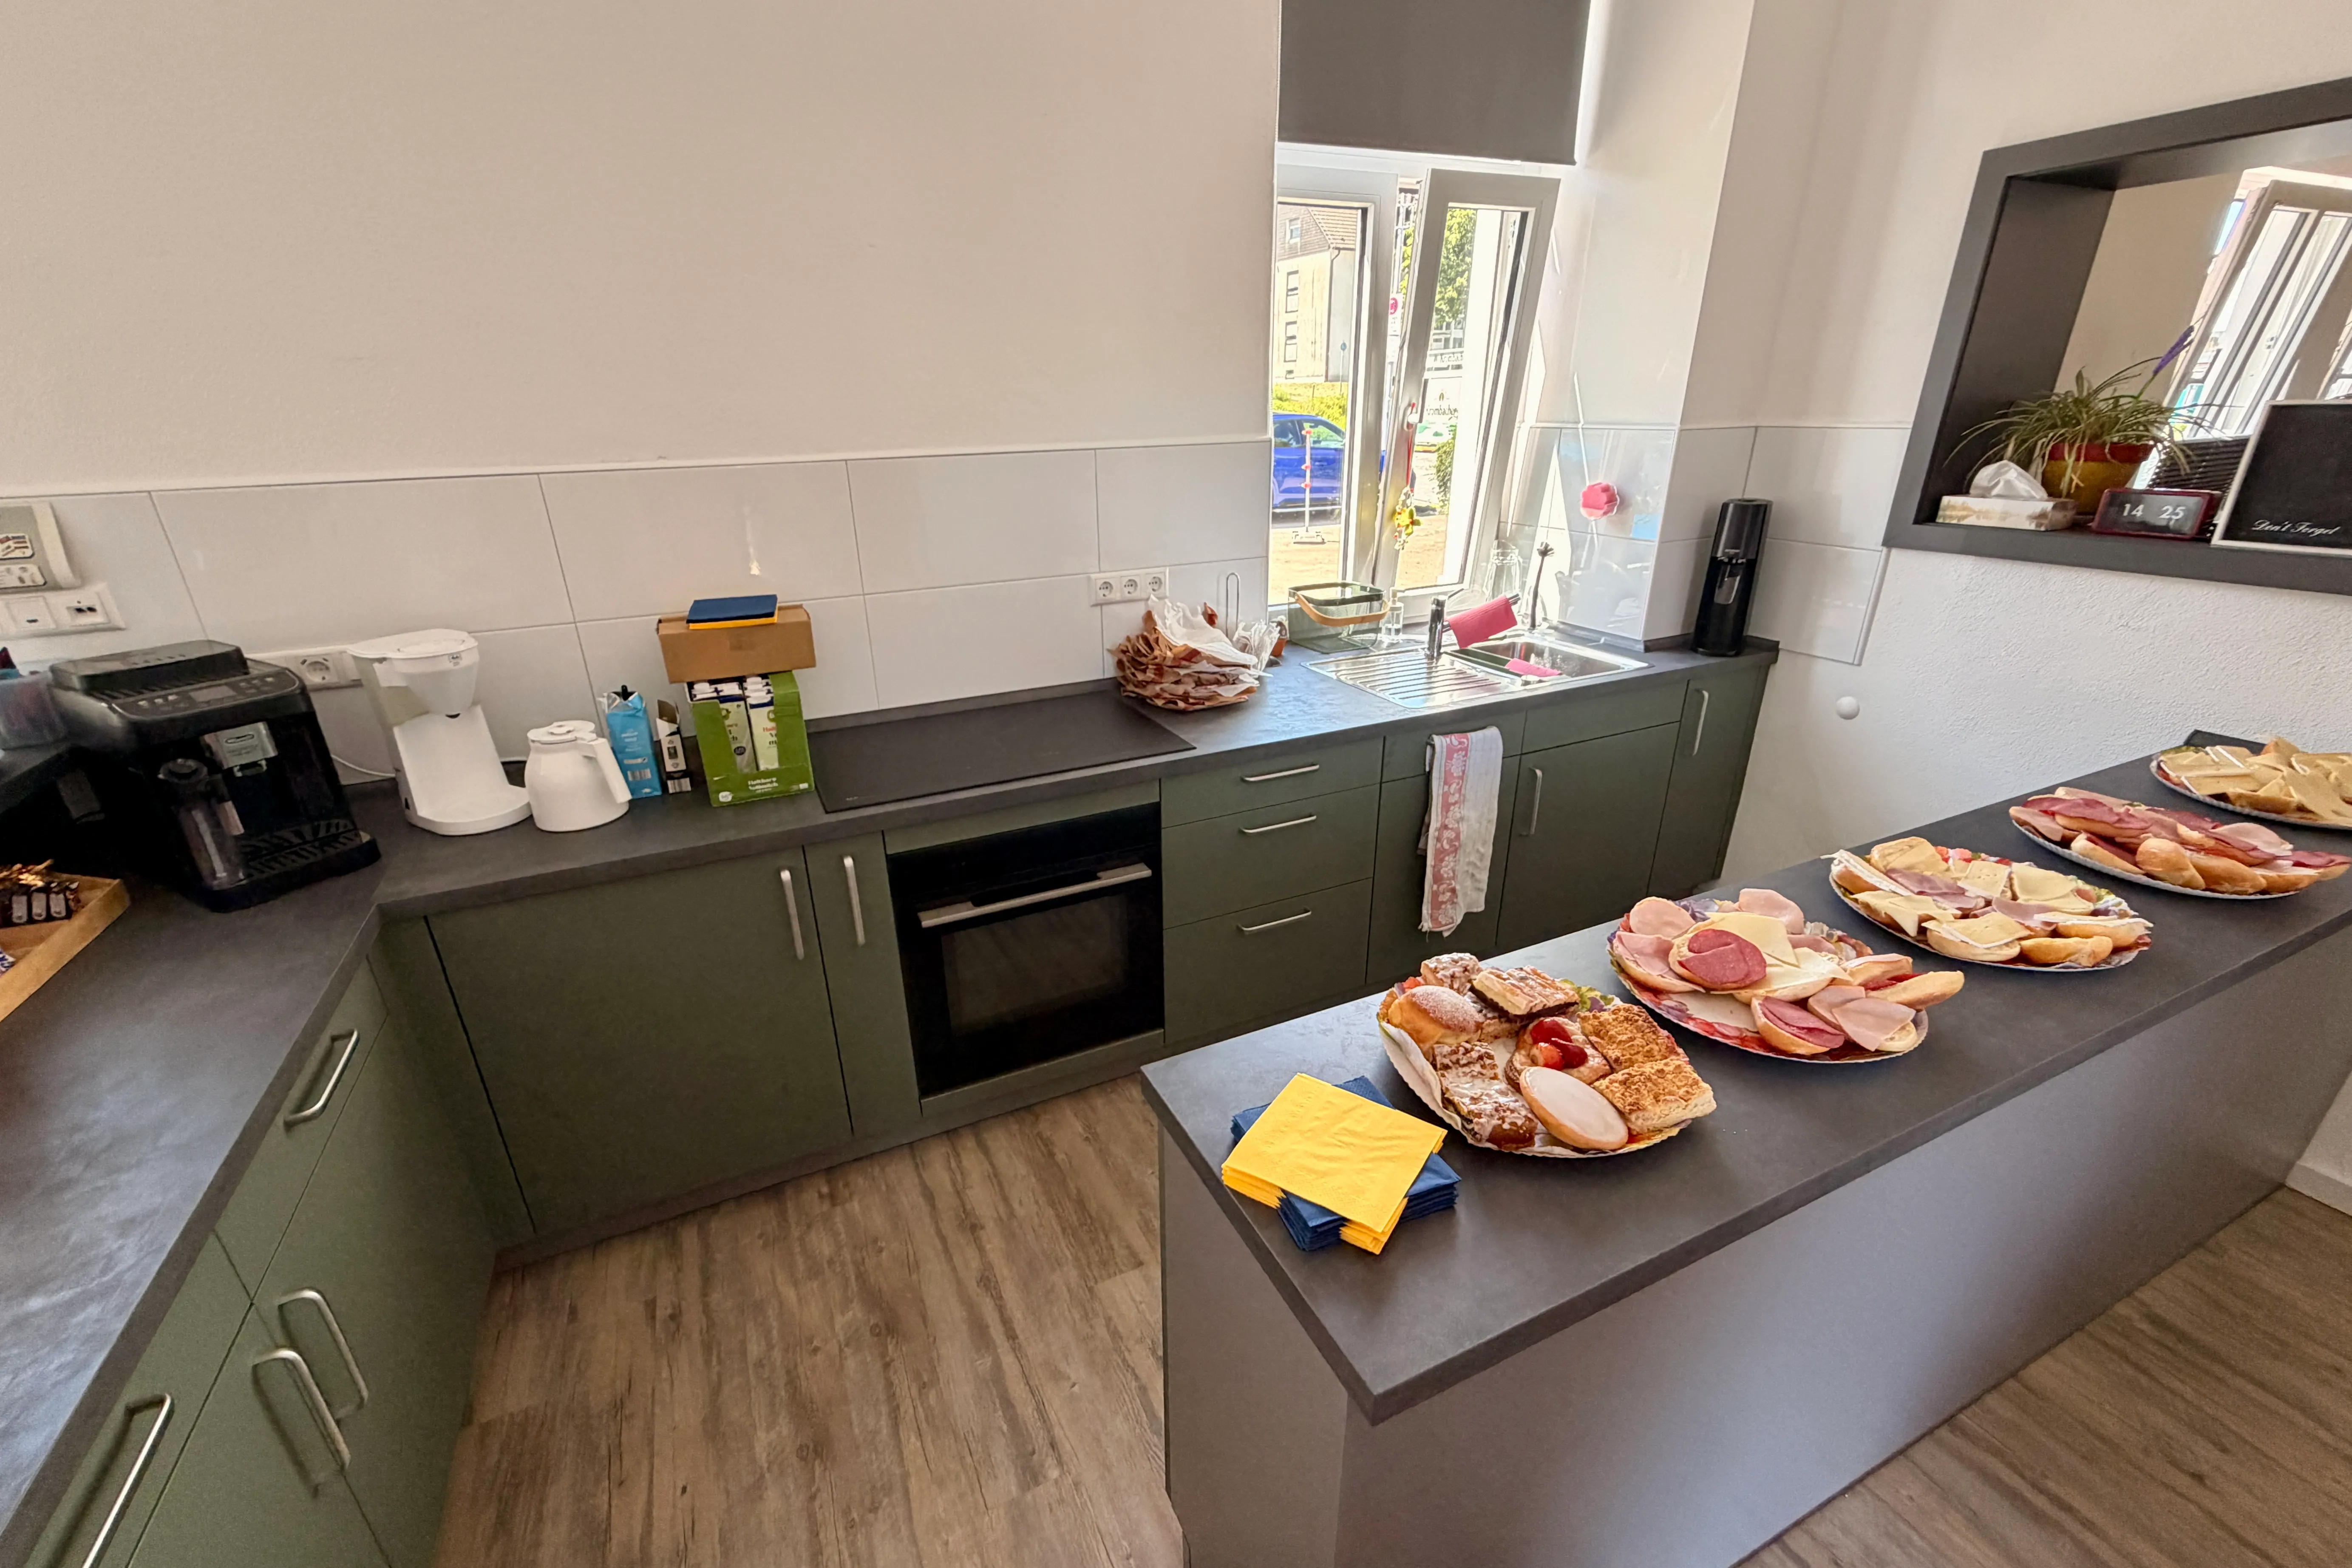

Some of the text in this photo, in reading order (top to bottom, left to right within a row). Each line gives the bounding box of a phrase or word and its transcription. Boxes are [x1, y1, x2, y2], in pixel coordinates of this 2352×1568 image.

[2122, 503, 2187, 519] 14 25
[2252, 519, 2341, 537] Don't Forget
